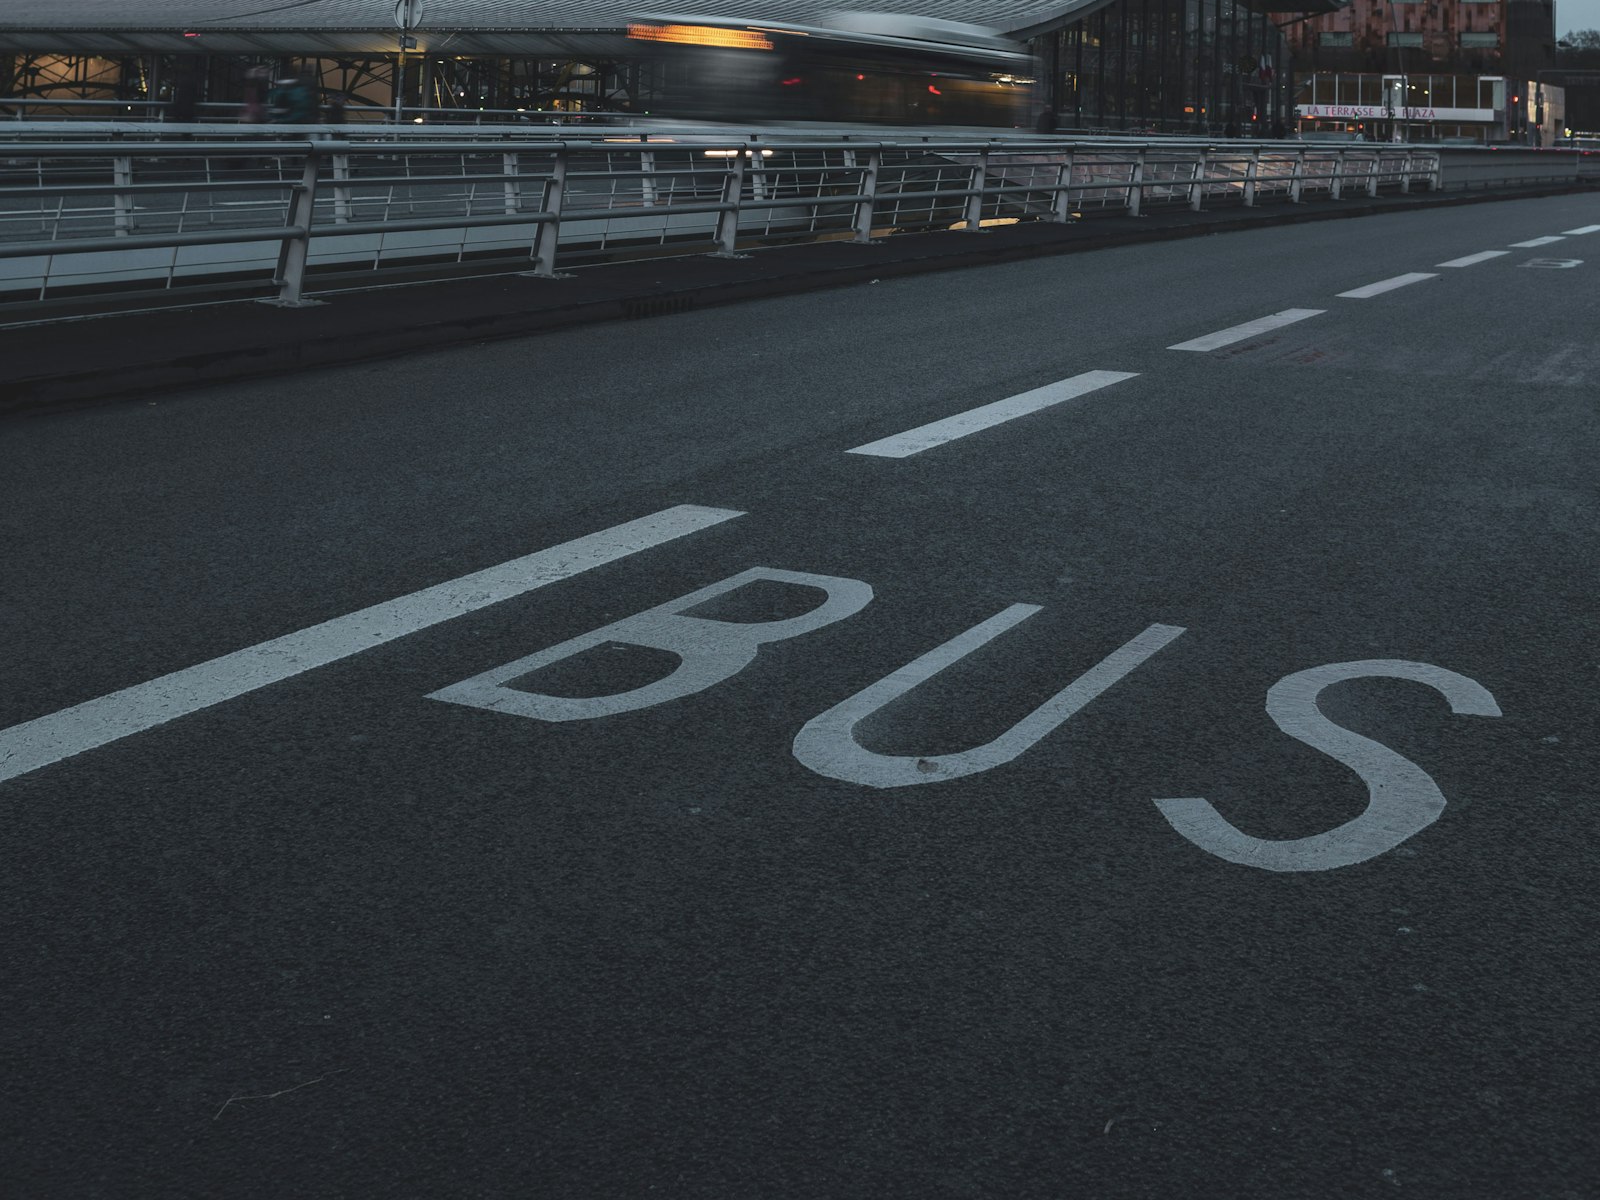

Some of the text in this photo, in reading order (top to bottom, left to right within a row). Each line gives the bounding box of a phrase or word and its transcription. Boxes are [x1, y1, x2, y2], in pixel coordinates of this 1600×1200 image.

[1307, 106, 1320, 115] LA
[1324, 106, 1374, 116] TERRASSE
[422, 566, 1503, 872] BUS
